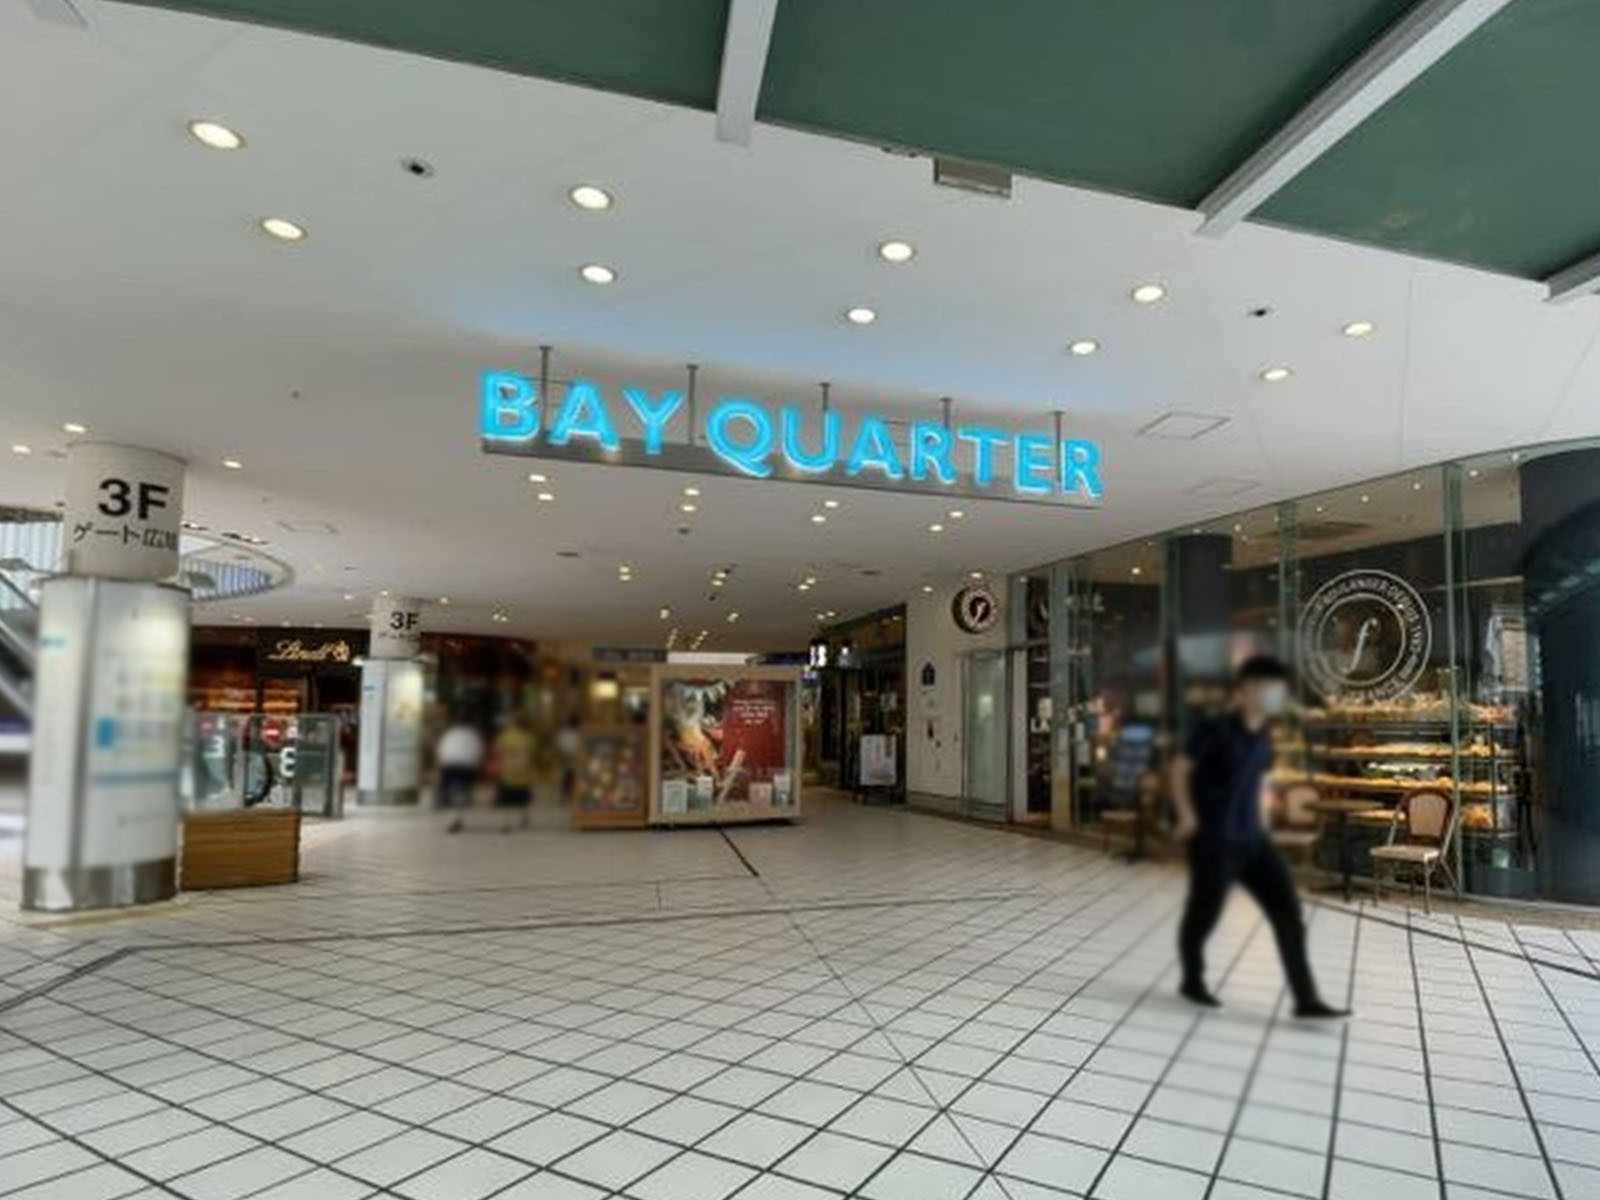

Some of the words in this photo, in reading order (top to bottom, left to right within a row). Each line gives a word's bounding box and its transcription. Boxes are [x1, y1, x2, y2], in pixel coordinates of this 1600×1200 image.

[478, 367, 684, 457] BAY
[705, 395, 1104, 499] QUARTER
[98, 477, 170, 520] 3F
[390, 611, 419, 631] 3F
